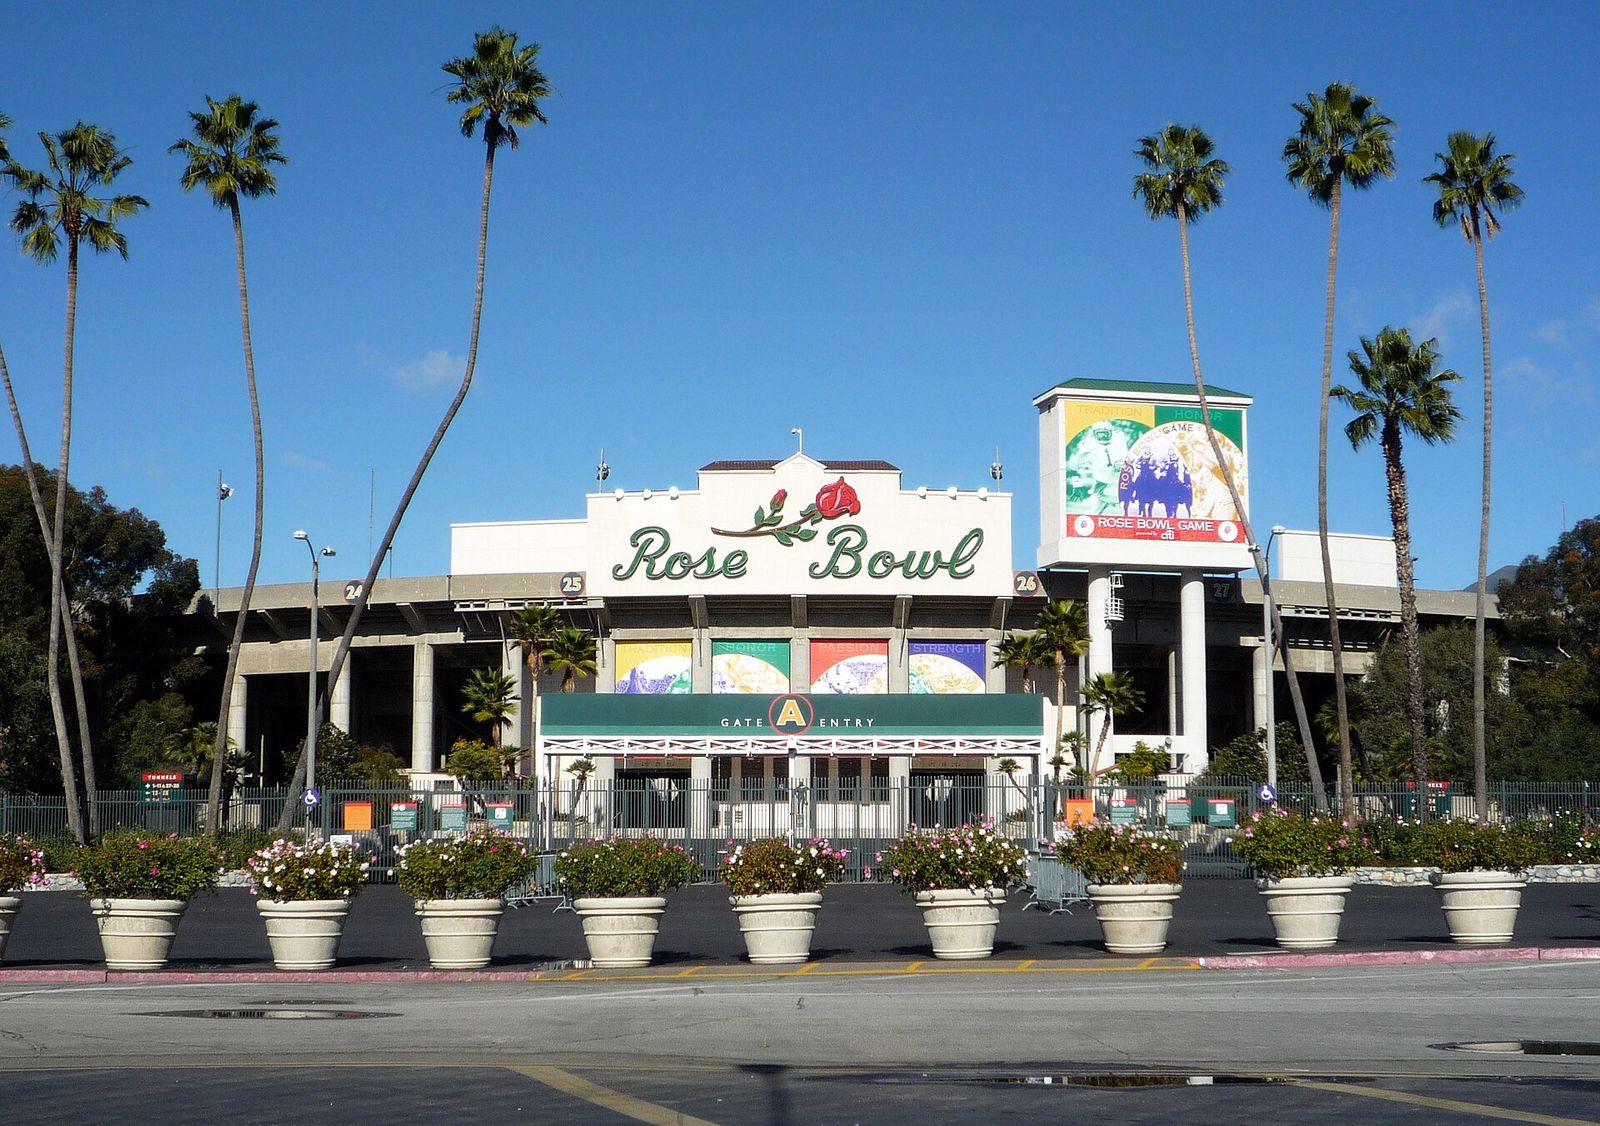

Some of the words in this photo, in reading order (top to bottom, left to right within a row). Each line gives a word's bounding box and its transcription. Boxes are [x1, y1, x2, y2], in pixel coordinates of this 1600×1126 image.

[1076, 404, 1143, 417] TRADITION
[1163, 423, 1195, 434] GAME
[1098, 518, 1134, 529] ROSE
[1137, 519, 1175, 530] BOWL
[1177, 520, 1214, 532] GAME
[612, 526, 749, 580] Rose
[808, 524, 985, 579] Bowl
[562, 576, 582, 592] 25
[1016, 575, 1037, 591] 26
[346, 584, 363, 600] 24
[1214, 583, 1230, 598] 27
[622, 643, 688, 654] TRADITION
[725, 642, 777, 652] HONOR
[819, 643, 880, 653] PASSION
[912, 643, 981, 653] STRENGTH
[721, 718, 763, 728] GATE
[776, 699, 807, 726] A
[819, 718, 875, 728] ENTRY
